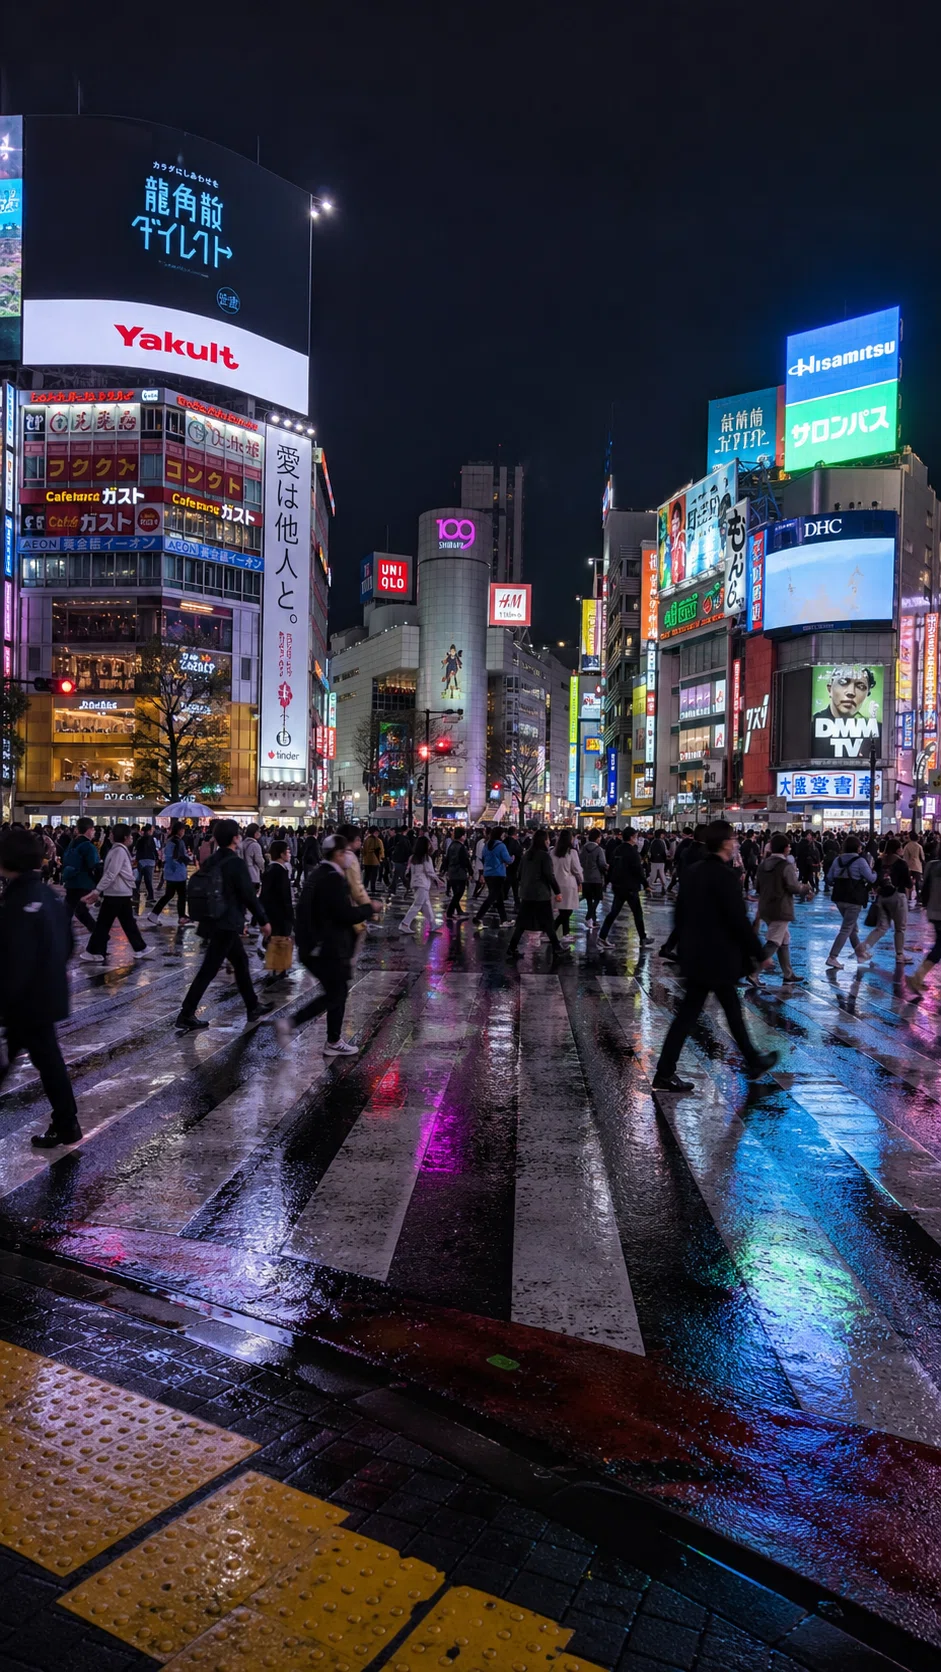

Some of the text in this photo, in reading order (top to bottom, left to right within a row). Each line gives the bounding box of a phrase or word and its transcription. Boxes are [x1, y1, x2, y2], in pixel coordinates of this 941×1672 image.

[145, 175, 223, 232] 龍角散
[131, 215, 233, 268] ダイレクト
[113, 324, 240, 370] Yakult
[788, 340, 895, 376] Hisamitsu
[791, 405, 889, 448] サロンパス
[102, 486, 145, 505] ガスト
[80, 512, 132, 532] ガスト
[221, 503, 255, 526] ガスト
[275, 444, 300, 624] 愛は他人と。
[436, 518, 476, 549] 109
[804, 518, 842, 537] DHC
[22, 539, 57, 549] AEON
[381, 564, 402, 576] UNI
[381, 577, 404, 590] QLO
[815, 717, 879, 738] DMM
[276, 750, 300, 761] tinder
[830, 738, 864, 757] TV
